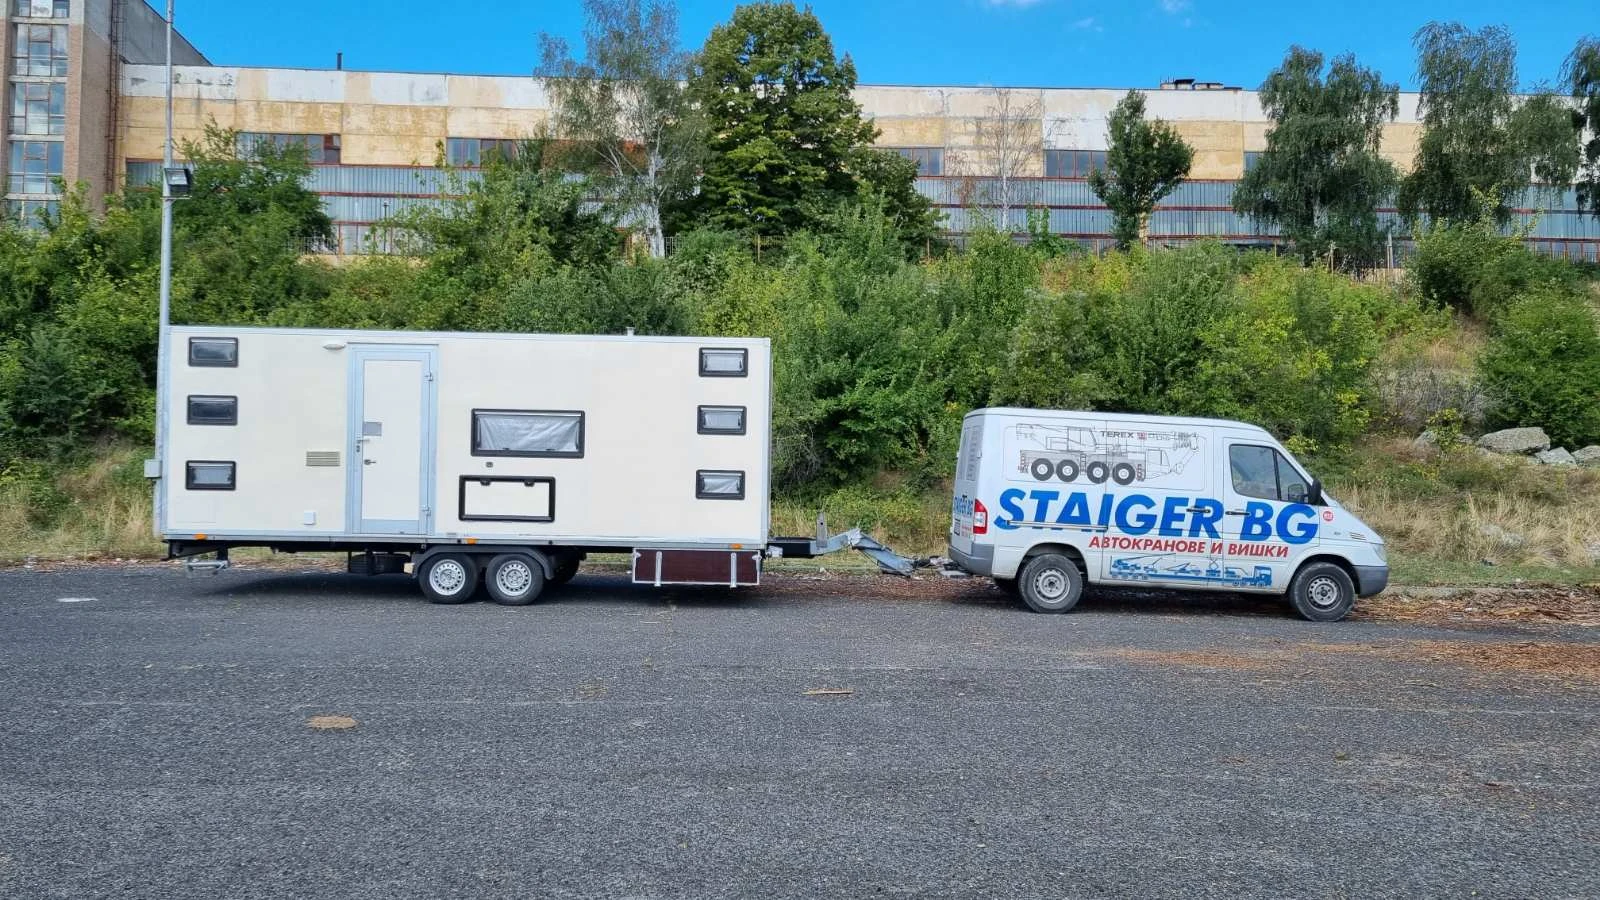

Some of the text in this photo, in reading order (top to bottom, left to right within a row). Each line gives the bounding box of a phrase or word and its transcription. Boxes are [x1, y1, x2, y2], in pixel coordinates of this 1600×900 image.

[1100, 430, 1134, 439] TEREX
[994, 489, 1223, 539] STAIGER
[1240, 501, 1318, 544] BG
[1088, 536, 1289, 557] АВТОКРАНОВЕ И ВИШКИ
